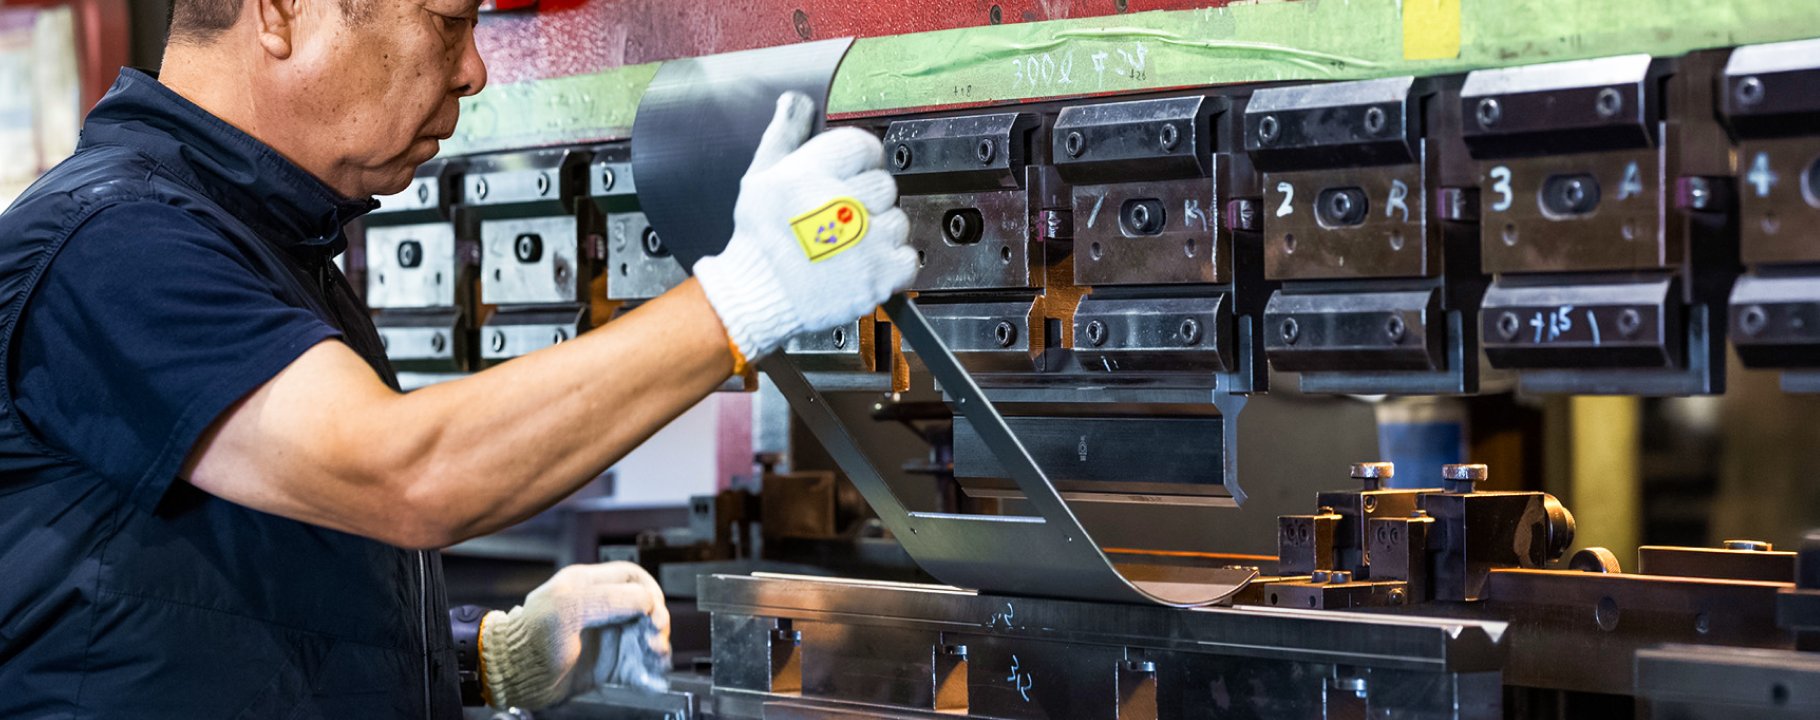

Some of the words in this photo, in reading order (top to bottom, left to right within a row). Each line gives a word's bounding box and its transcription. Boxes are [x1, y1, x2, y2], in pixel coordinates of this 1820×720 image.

[1276, 182, 1295, 217] 2
[1386, 179, 1409, 223] R
[1490, 167, 1513, 212] 3
